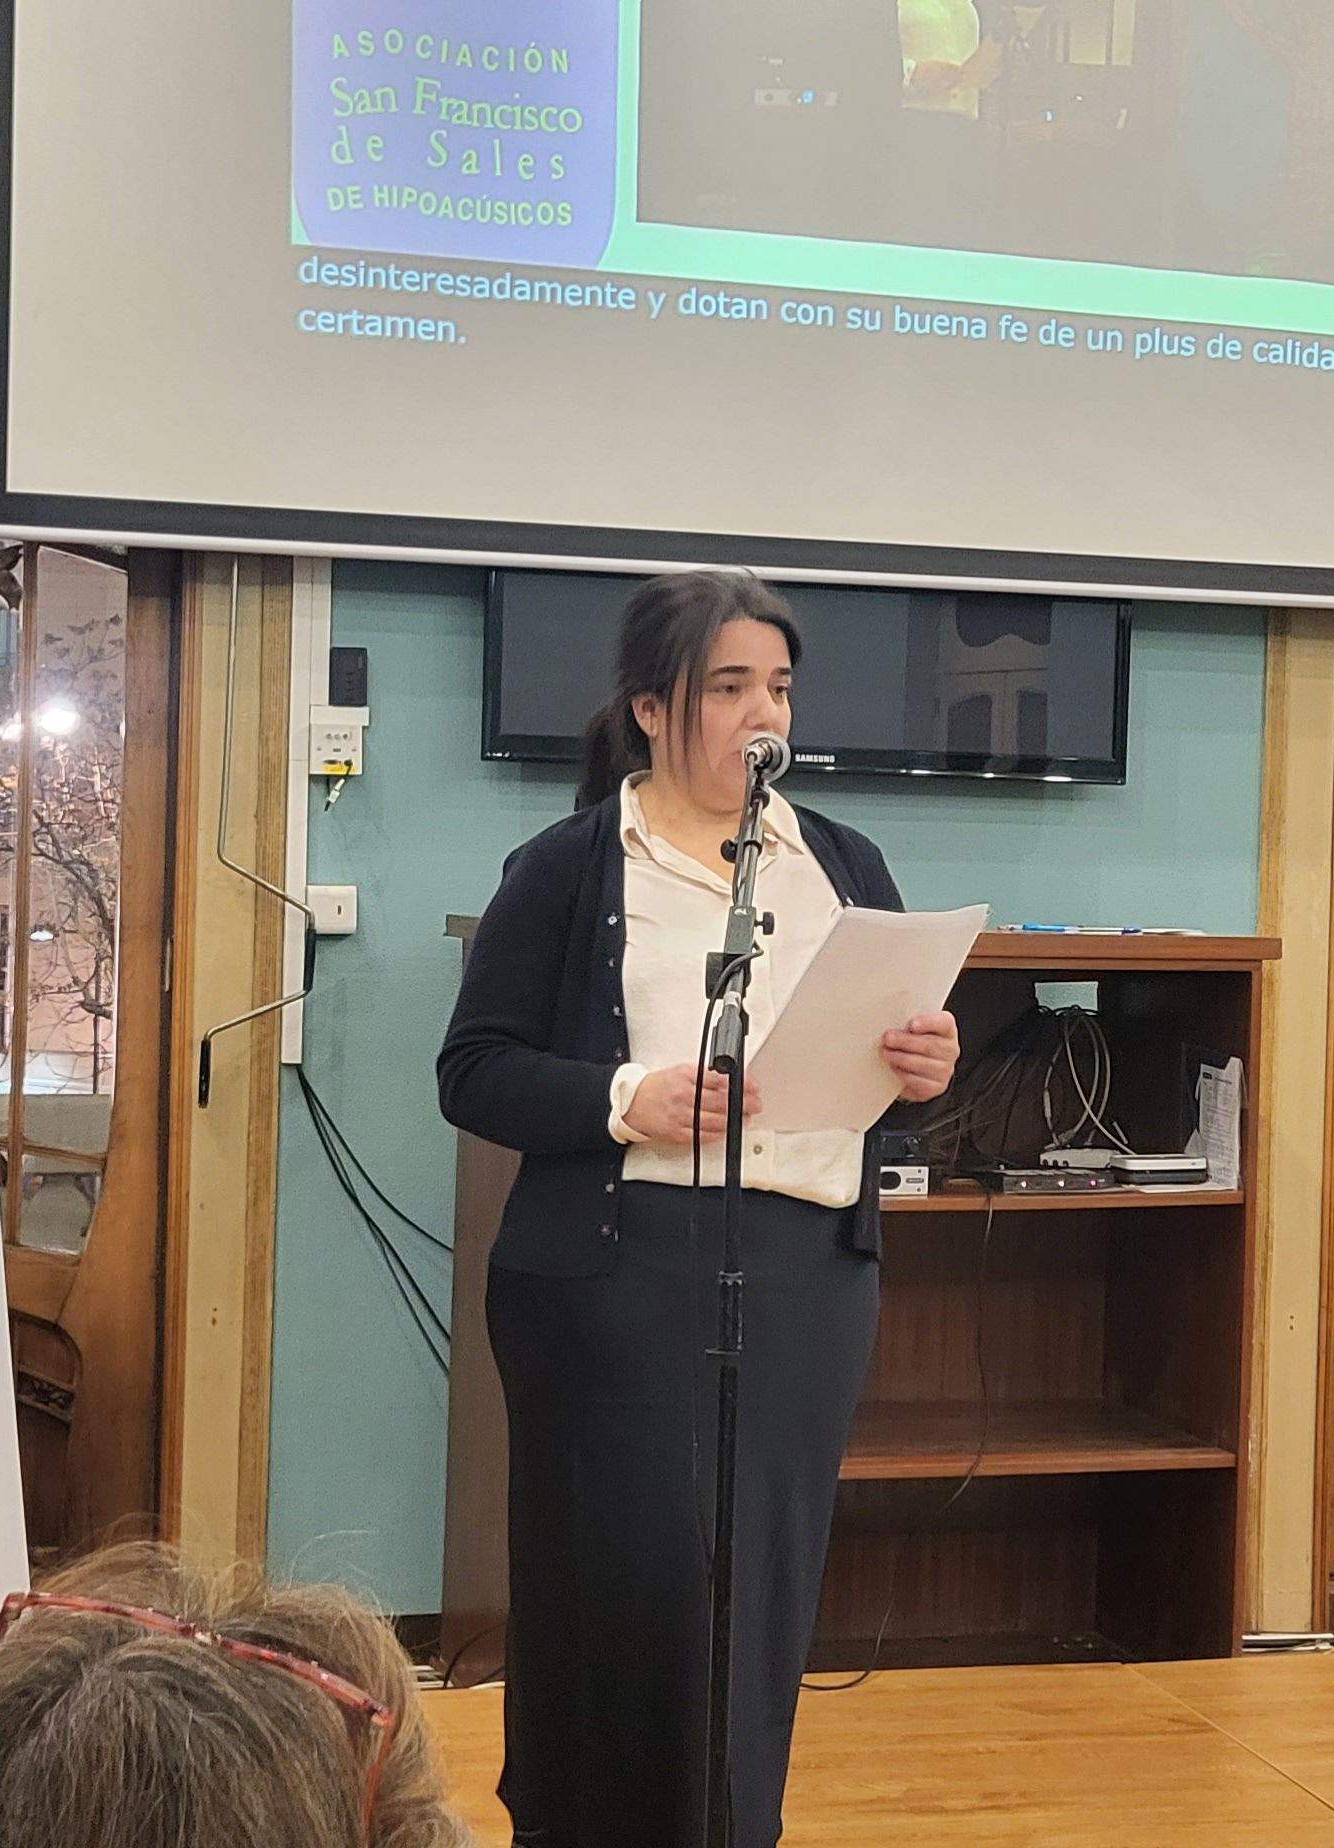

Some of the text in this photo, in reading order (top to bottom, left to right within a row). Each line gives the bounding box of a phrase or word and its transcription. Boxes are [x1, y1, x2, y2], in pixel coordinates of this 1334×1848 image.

[331, 28, 568, 74] ASOCIACIÓN
[330, 77, 583, 132] San Francisco
[330, 126, 566, 180] de Sales
[326, 185, 572, 226] DE HIPOACÚSICOS
[298, 256, 636, 310] desinteresadamente
[648, 291, 666, 319] y
[678, 287, 768, 320] dotan
[780, 300, 834, 326] con
[846, 307, 881, 331] su
[894, 305, 987, 339] buena
[998, 314, 1028, 342] fe
[1038, 319, 1075, 348] de
[1087, 328, 1123, 352] un
[1134, 327, 1196, 359] plus
[1206, 332, 1242, 360] de
[298, 306, 467, 344] certamen.
[795, 753, 835, 763] SAMSUNG
